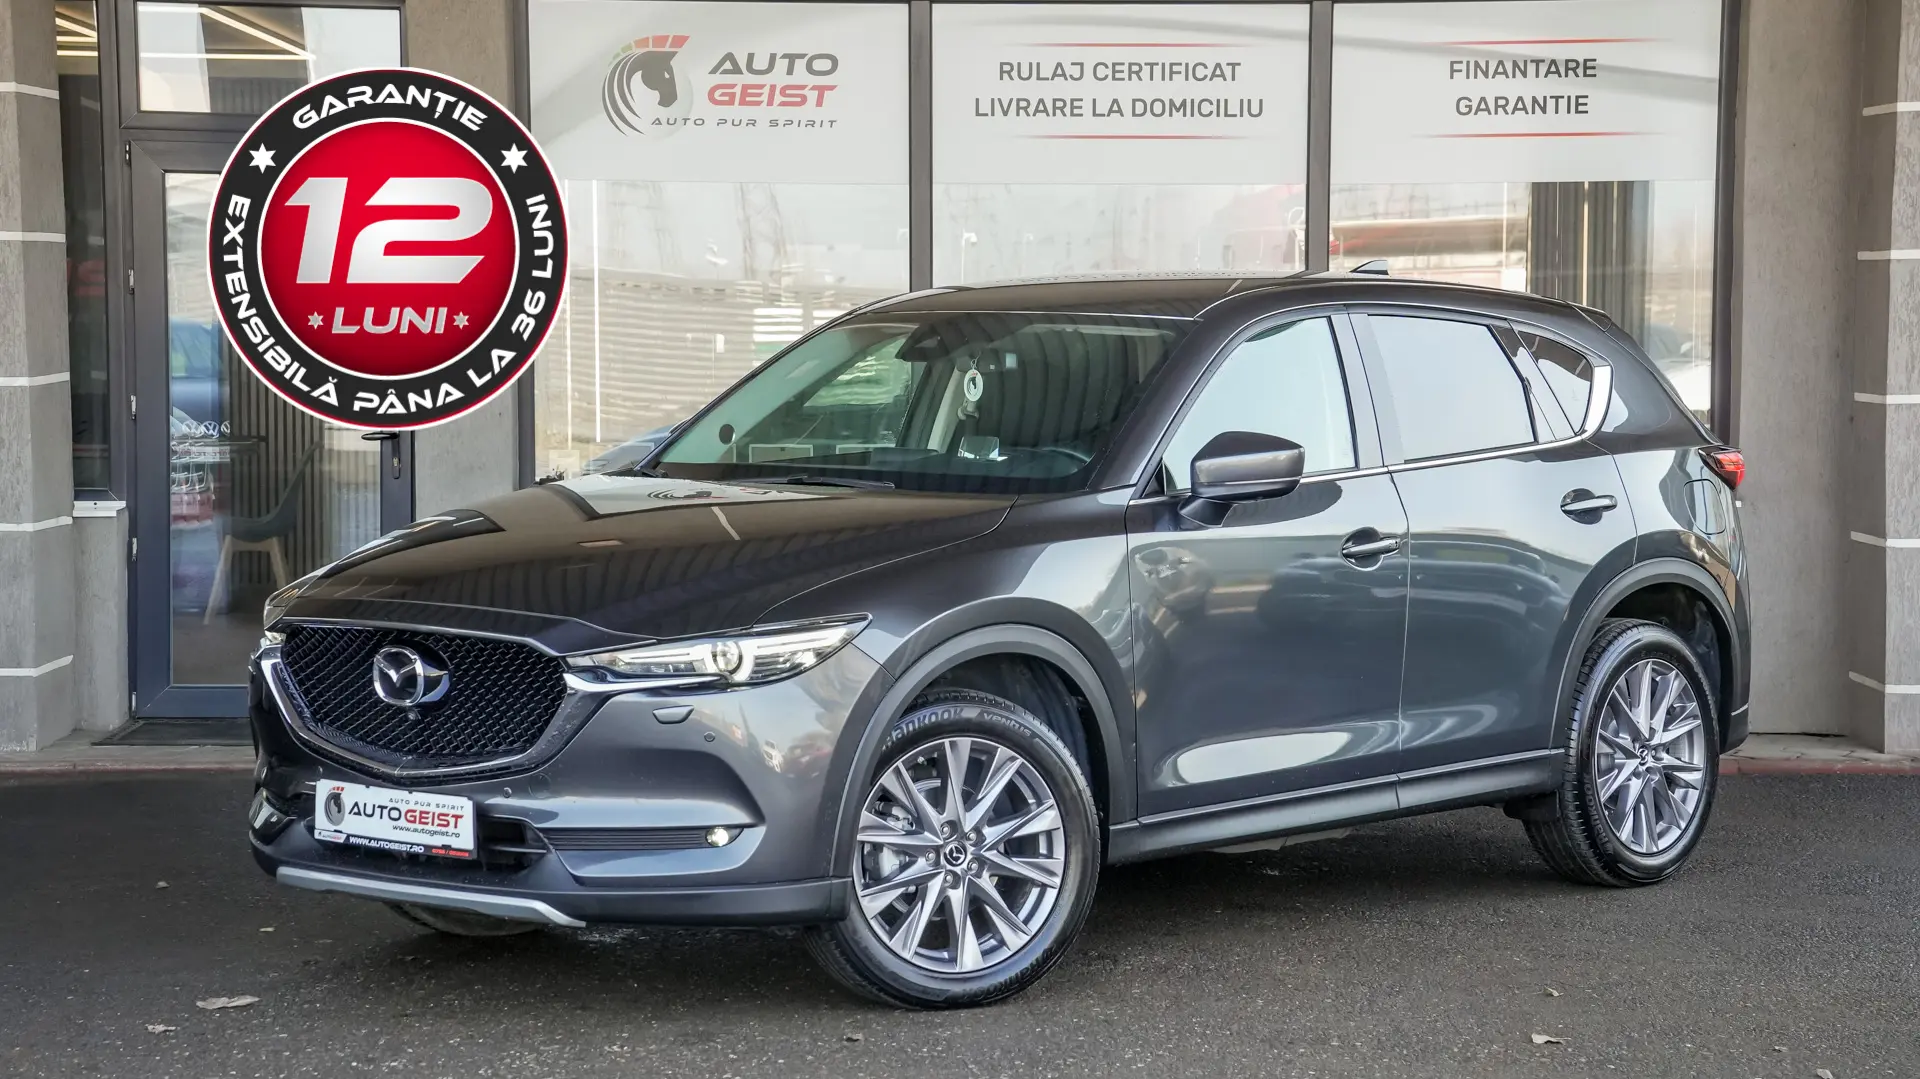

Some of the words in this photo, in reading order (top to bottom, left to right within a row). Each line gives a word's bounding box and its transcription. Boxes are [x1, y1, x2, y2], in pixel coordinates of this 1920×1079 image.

[708, 52, 839, 76] AUTO
[999, 61, 1085, 81] RULAJ
[1092, 62, 1242, 82] CERTIFICAT
[1449, 58, 1597, 80] FINANTARE
[707, 83, 839, 107] GEIST
[1455, 95, 1589, 116] GARANTIE
[975, 97, 1084, 117] LIVRARE
[1091, 98, 1124, 117] LA
[1131, 98, 1264, 118] DOMICILIU
[651, 117, 705, 127] AUTO
[716, 118, 757, 128] PUR
[768, 118, 837, 129] SPIRIT
[389, 797, 410, 805] AUTO
[435, 803, 465, 811] SPIRIT
[392, 824, 461, 838] www.autogeist.ro
[349, 836, 425, 853] WWW.AUTOGEIST.RO
